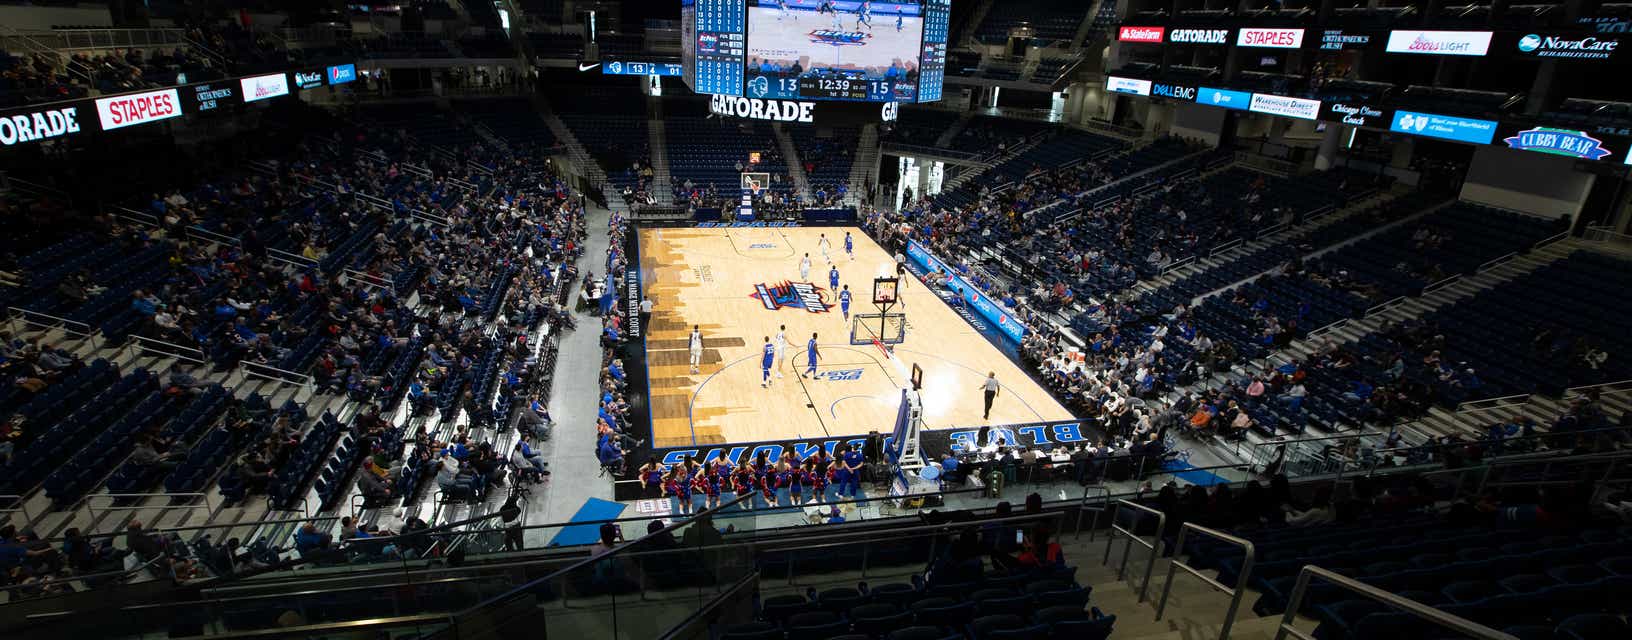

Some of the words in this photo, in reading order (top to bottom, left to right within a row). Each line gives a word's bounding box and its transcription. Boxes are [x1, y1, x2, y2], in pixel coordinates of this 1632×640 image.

[1170, 29, 1228, 43] GATORADE
[1245, 32, 1295, 45] STAPLES
[1540, 36, 1618, 50] NovaCare
[1440, 42, 1470, 51] LIGHT
[779, 79, 797, 91] 13
[819, 79, 850, 90] 12:39
[872, 82, 888, 94] 15
[109, 94, 173, 124] STAPLES
[712, 94, 814, 122] GATORADE
[1521, 134, 1561, 148] CUBBY
[1560, 136, 1594, 154] BEAR
[630, 318, 640, 336] COURT
[1005, 322, 1020, 338] pepsi
